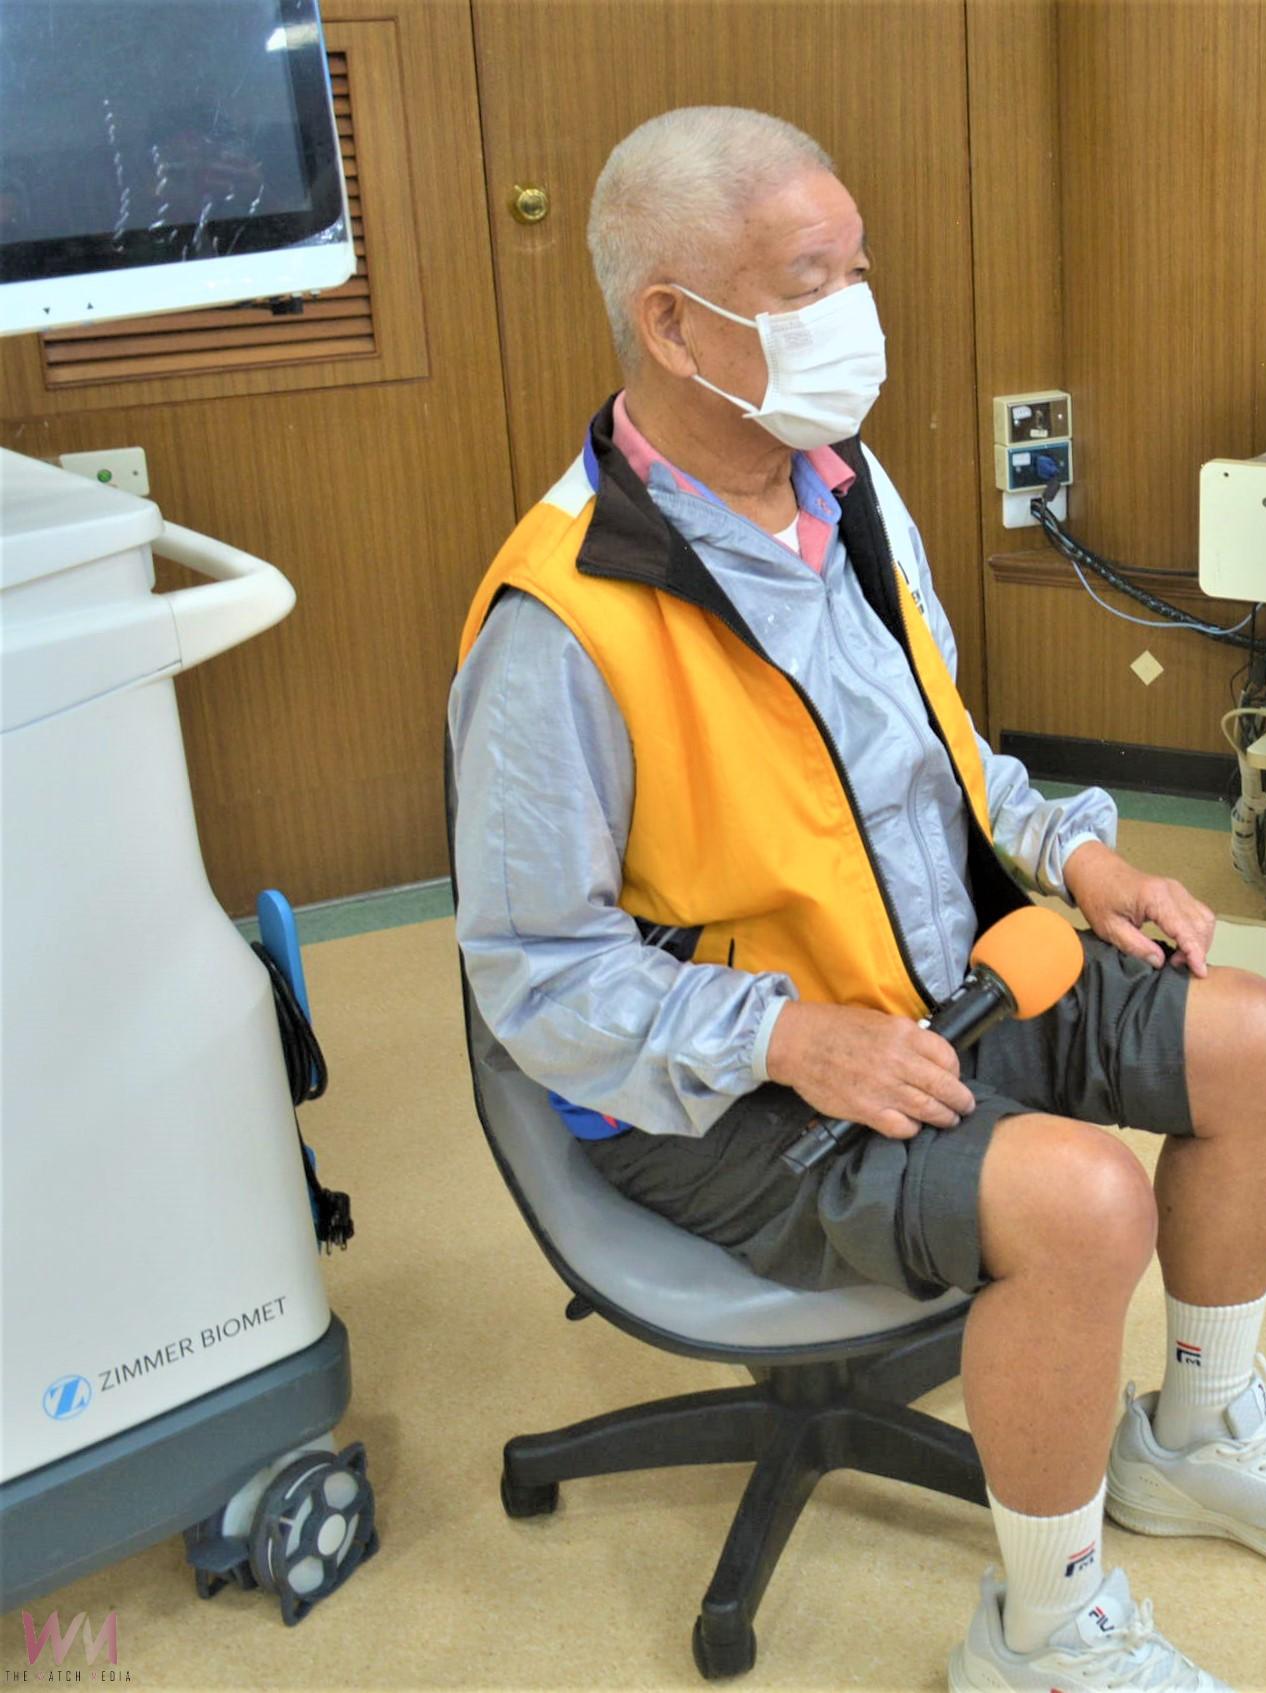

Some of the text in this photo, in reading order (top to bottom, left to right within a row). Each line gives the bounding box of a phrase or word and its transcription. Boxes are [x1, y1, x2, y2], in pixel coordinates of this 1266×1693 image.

[98, 1296, 287, 1392] ZIMMER BIOMET
[1088, 1606, 1115, 1638] FIL
